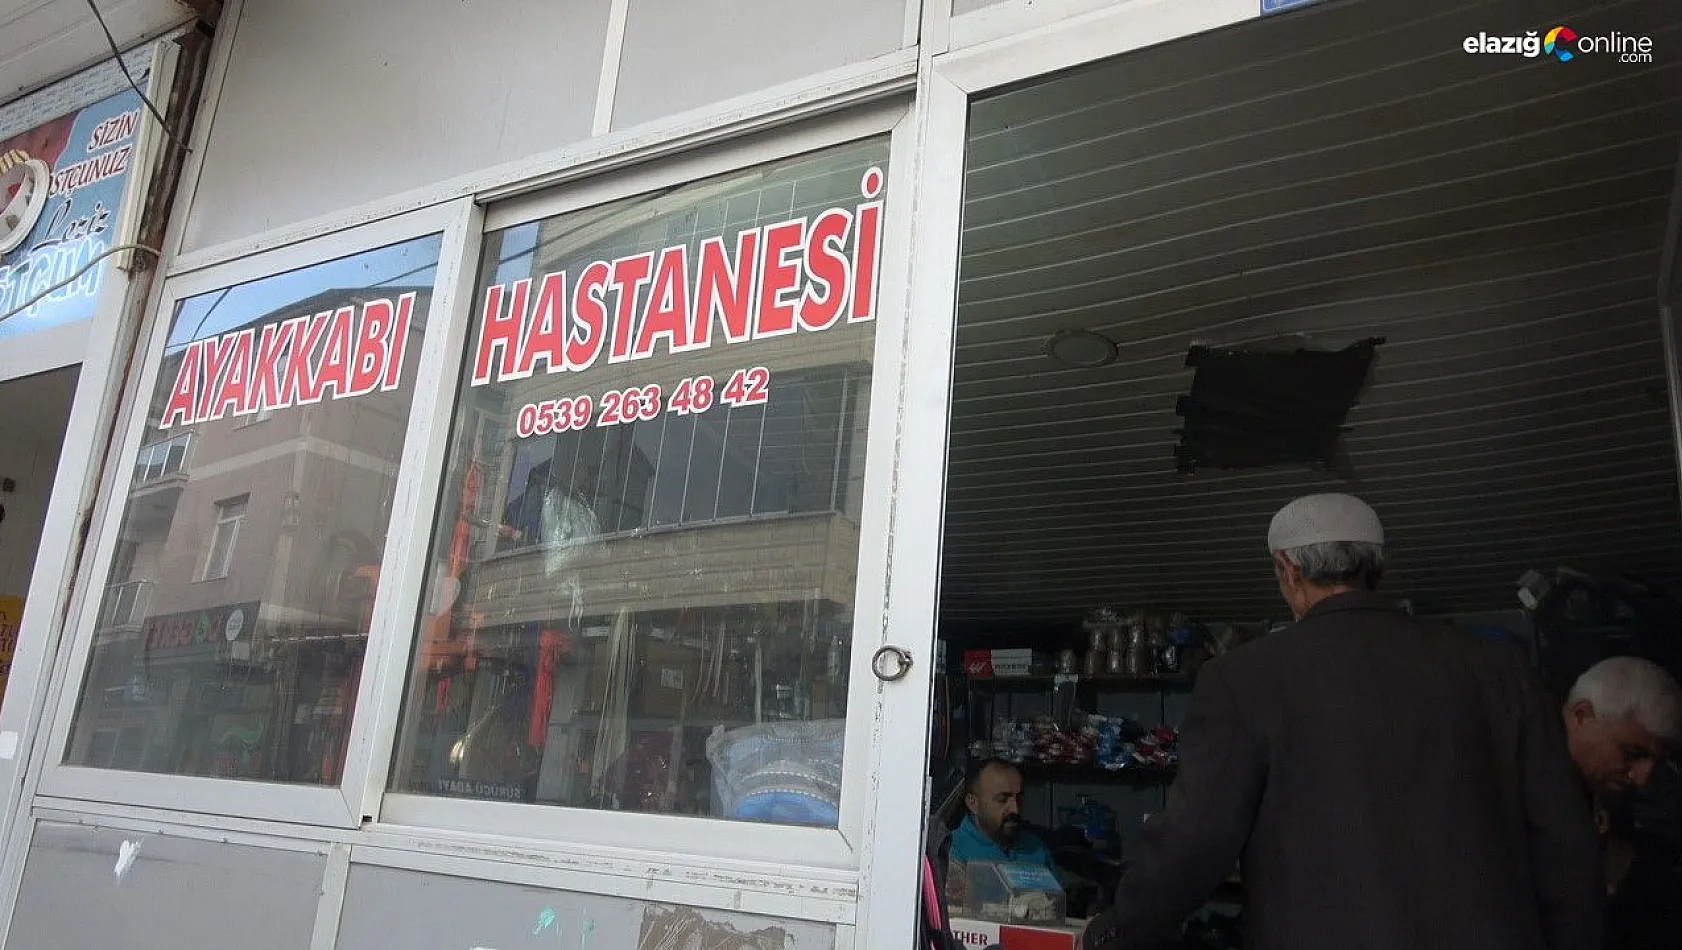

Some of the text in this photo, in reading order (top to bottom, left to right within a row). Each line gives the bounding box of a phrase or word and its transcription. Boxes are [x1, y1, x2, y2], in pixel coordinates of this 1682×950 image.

[88, 110, 140, 152] SİZİN
[471, 167, 884, 386] HASTANESİ
[159, 291, 417, 429] AYAKKABI
[517, 367, 770, 438] 0539 263 48 42
